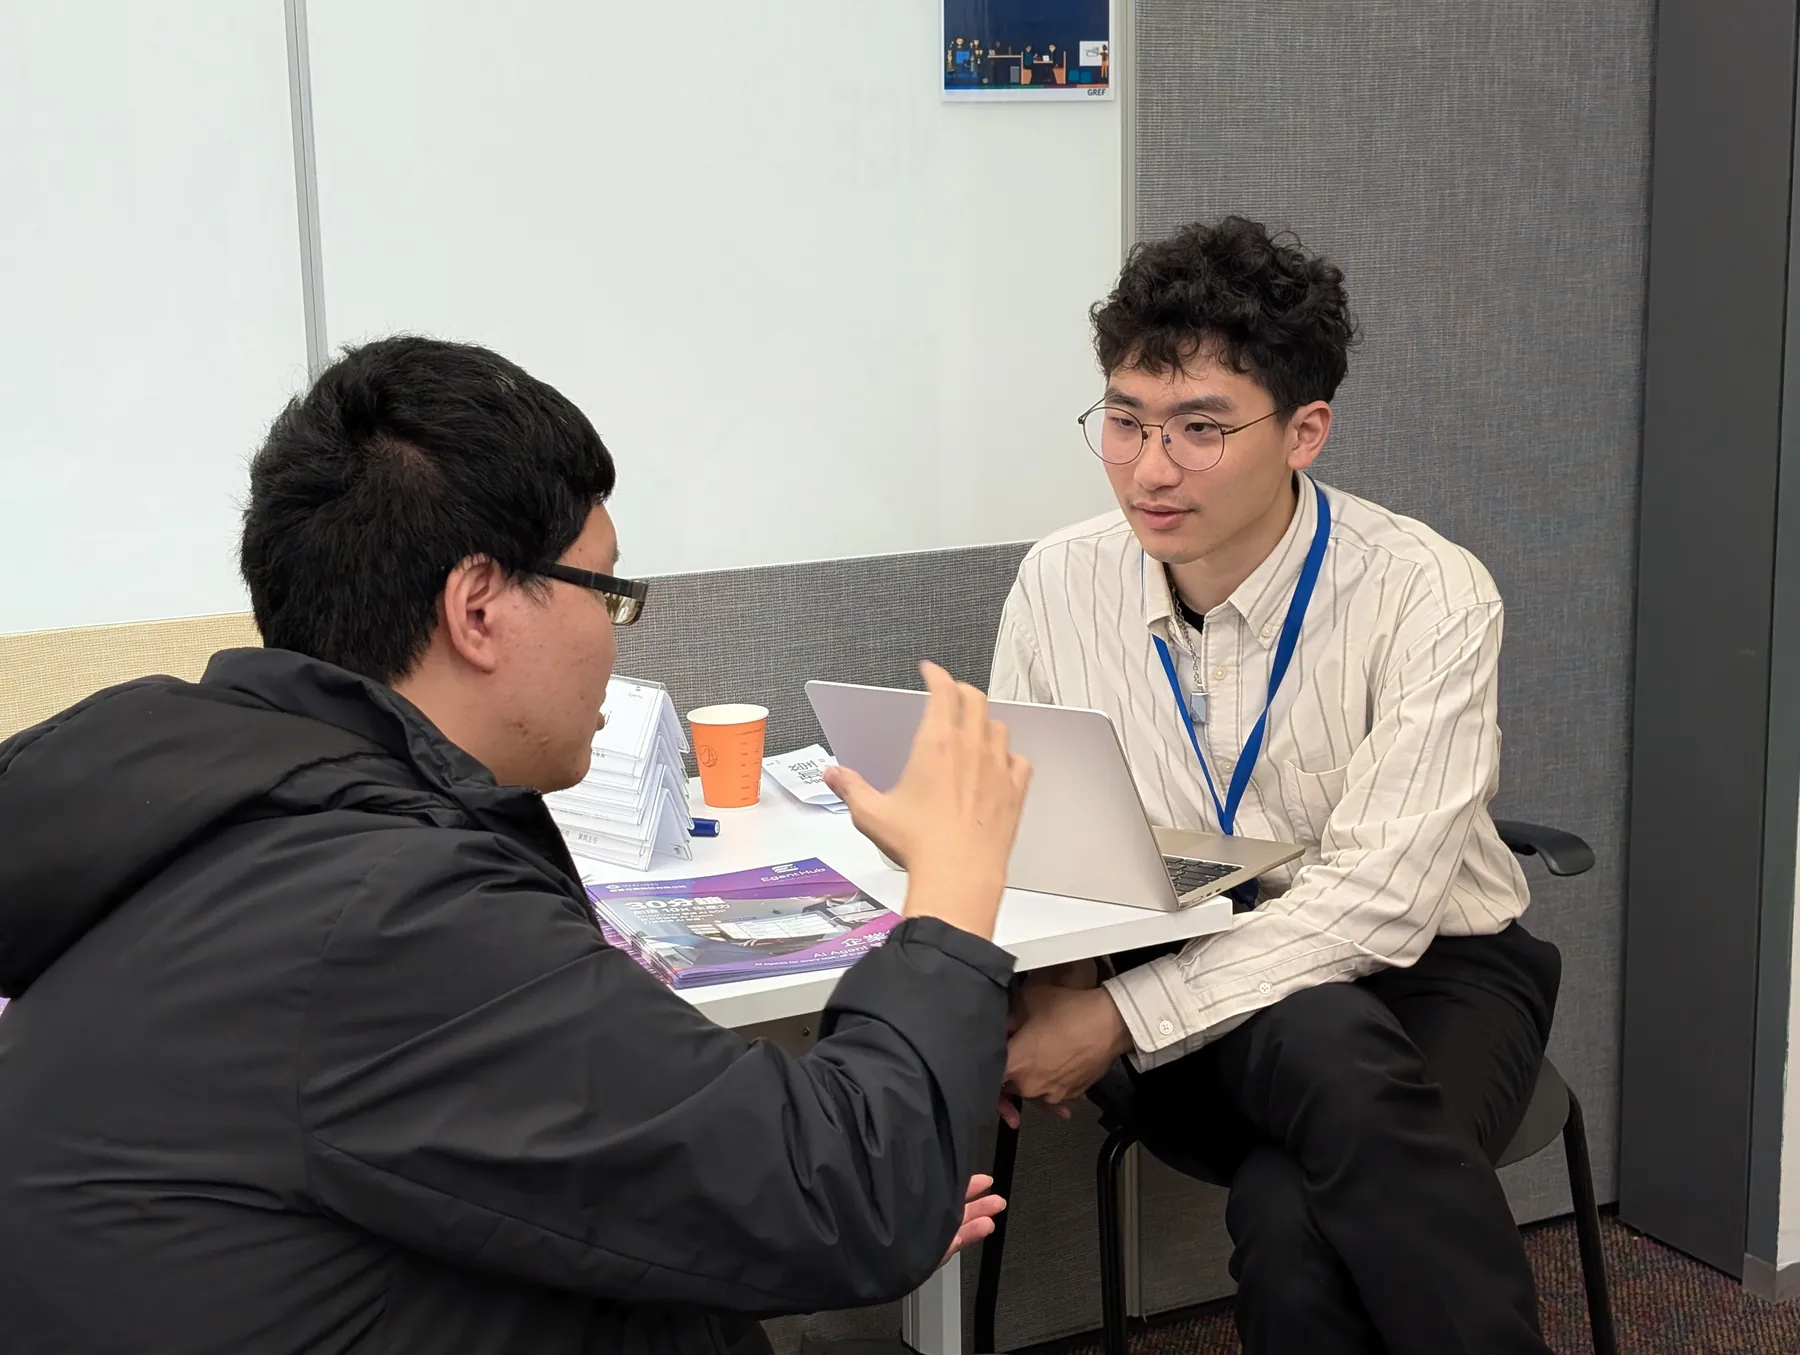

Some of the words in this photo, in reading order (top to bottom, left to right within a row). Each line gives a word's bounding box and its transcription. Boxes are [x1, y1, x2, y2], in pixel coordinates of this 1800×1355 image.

[1087, 88, 1106, 97] GREF
[841, 929, 891, 947] 企業
[830, 945, 869, 956] Agent
